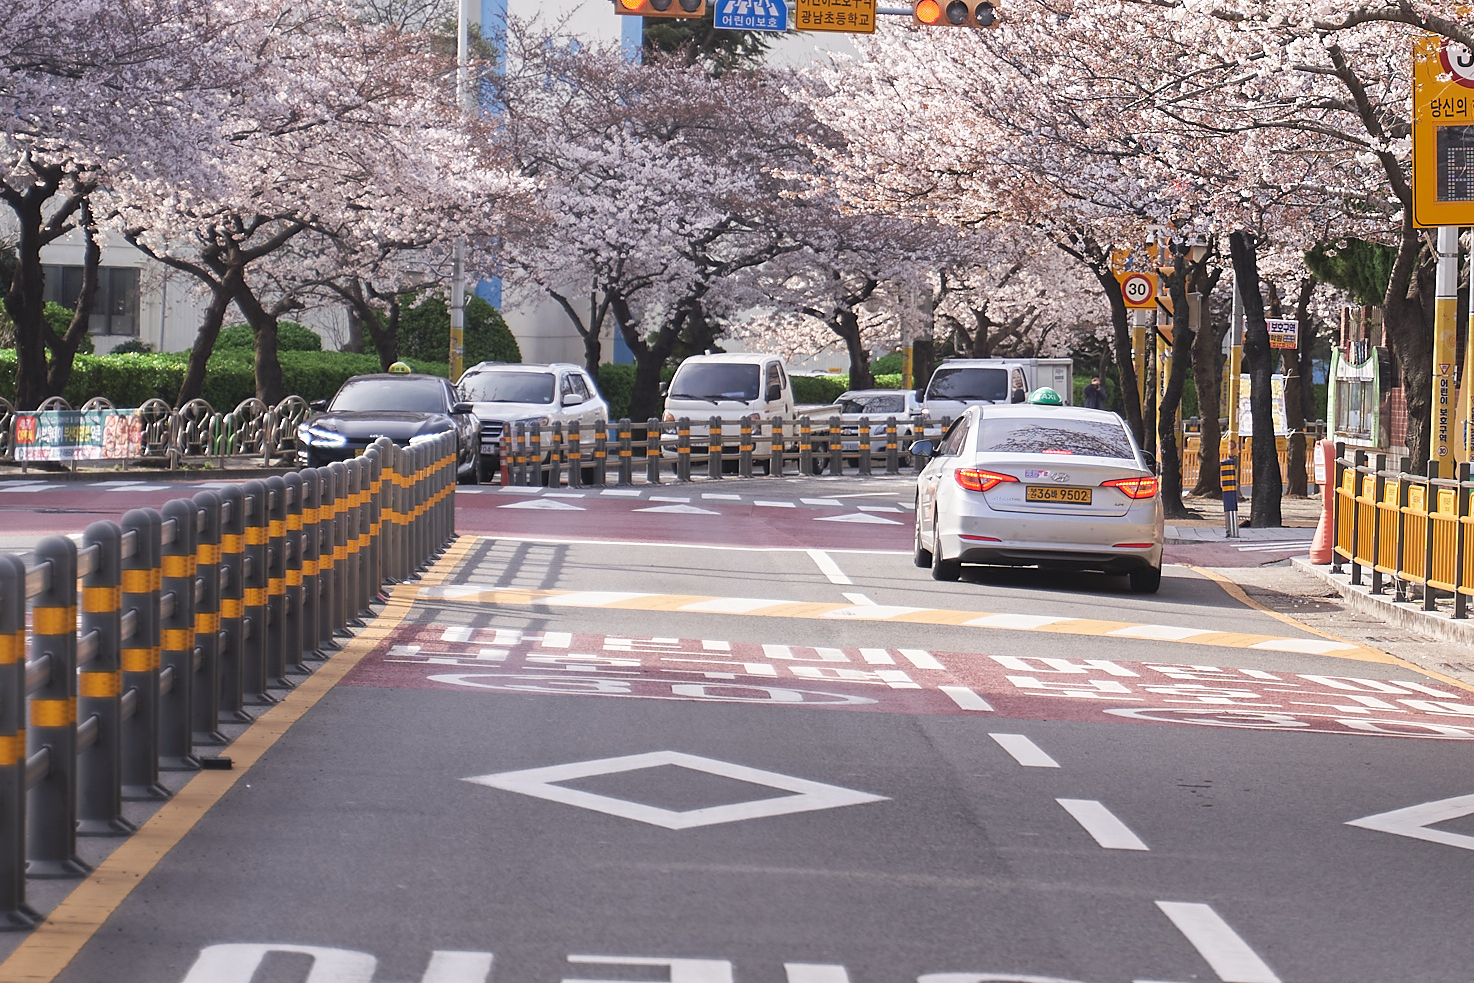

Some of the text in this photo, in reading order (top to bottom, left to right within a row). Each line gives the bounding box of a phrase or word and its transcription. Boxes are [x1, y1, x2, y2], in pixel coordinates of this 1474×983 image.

[721, 14, 778, 28] 어린이보호
[801, 10, 870, 27] 광남초등학교
[1430, 97, 1467, 118] 당신의
[1128, 283, 1146, 296] 30
[1439, 379, 1448, 443] 어린이 보호구역
[1060, 489, 1087, 501] 9502
[441, 626, 945, 670] 어린이
[383, 645, 922, 689] 보호구역
[988, 655, 1461, 699] 어린이
[503, 676, 804, 703] 30
